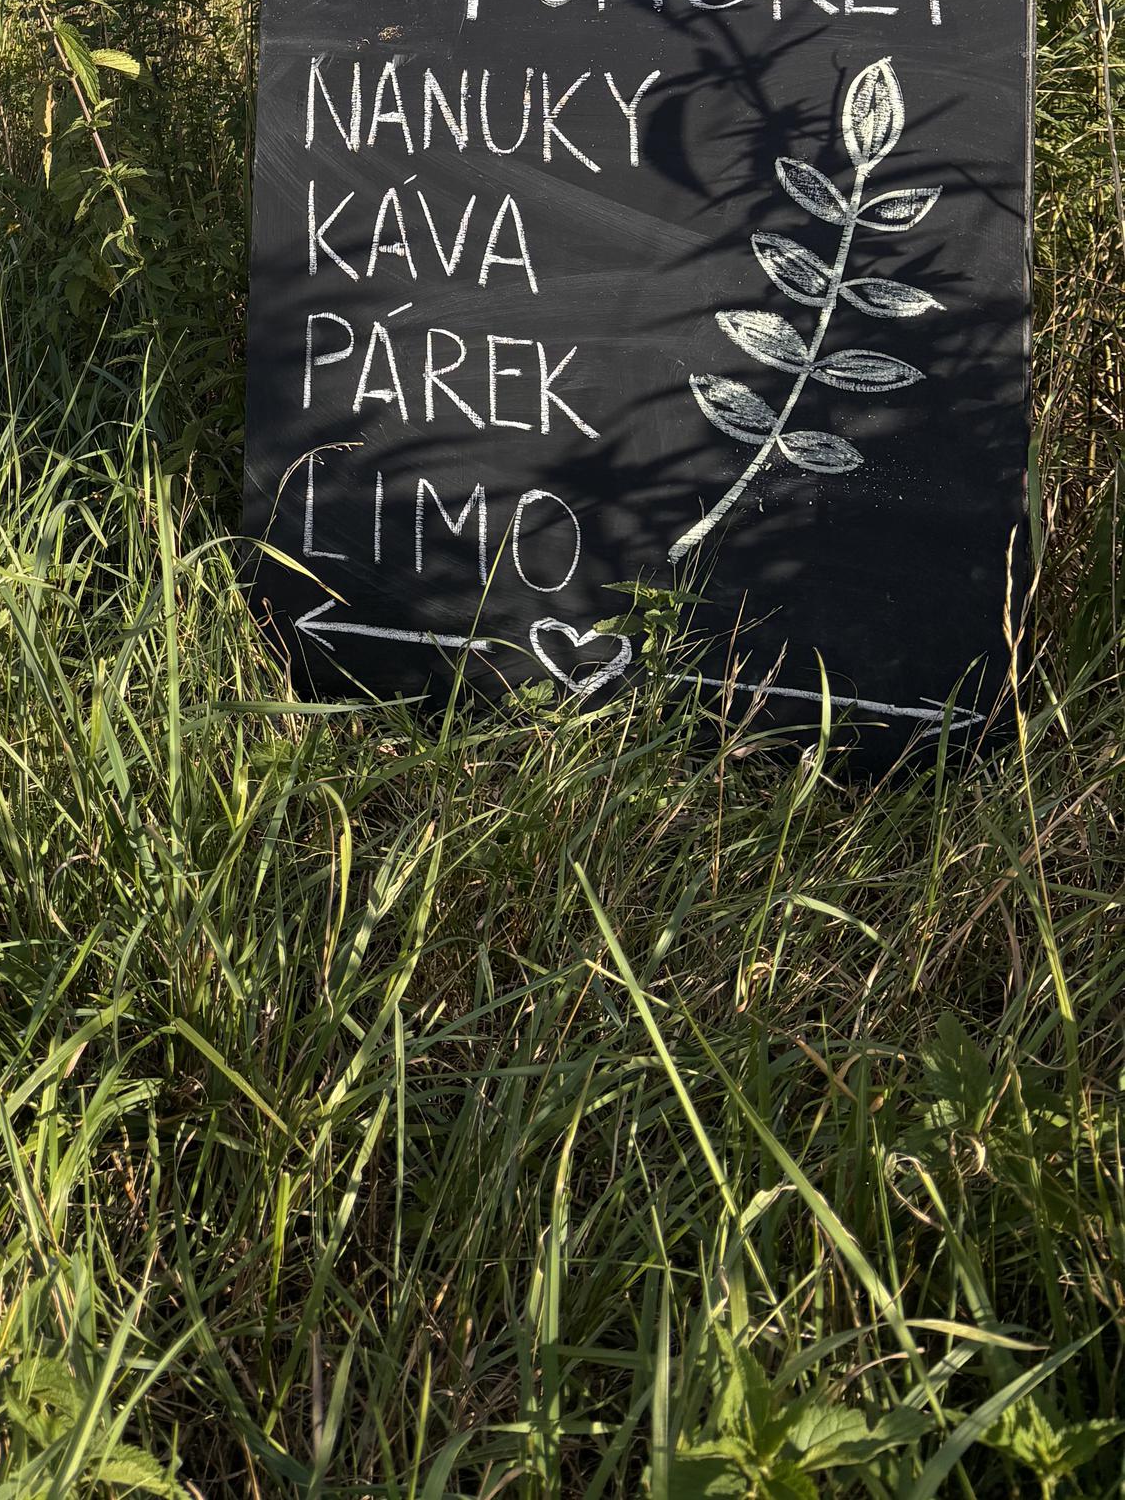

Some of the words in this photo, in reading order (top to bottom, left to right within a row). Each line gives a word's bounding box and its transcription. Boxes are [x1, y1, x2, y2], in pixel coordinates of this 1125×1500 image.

[305, 57, 661, 174] NANUKY
[307, 174, 539, 294] KÁVA
[302, 301, 600, 441] PÁREK
[303, 454, 581, 592] LIMO
